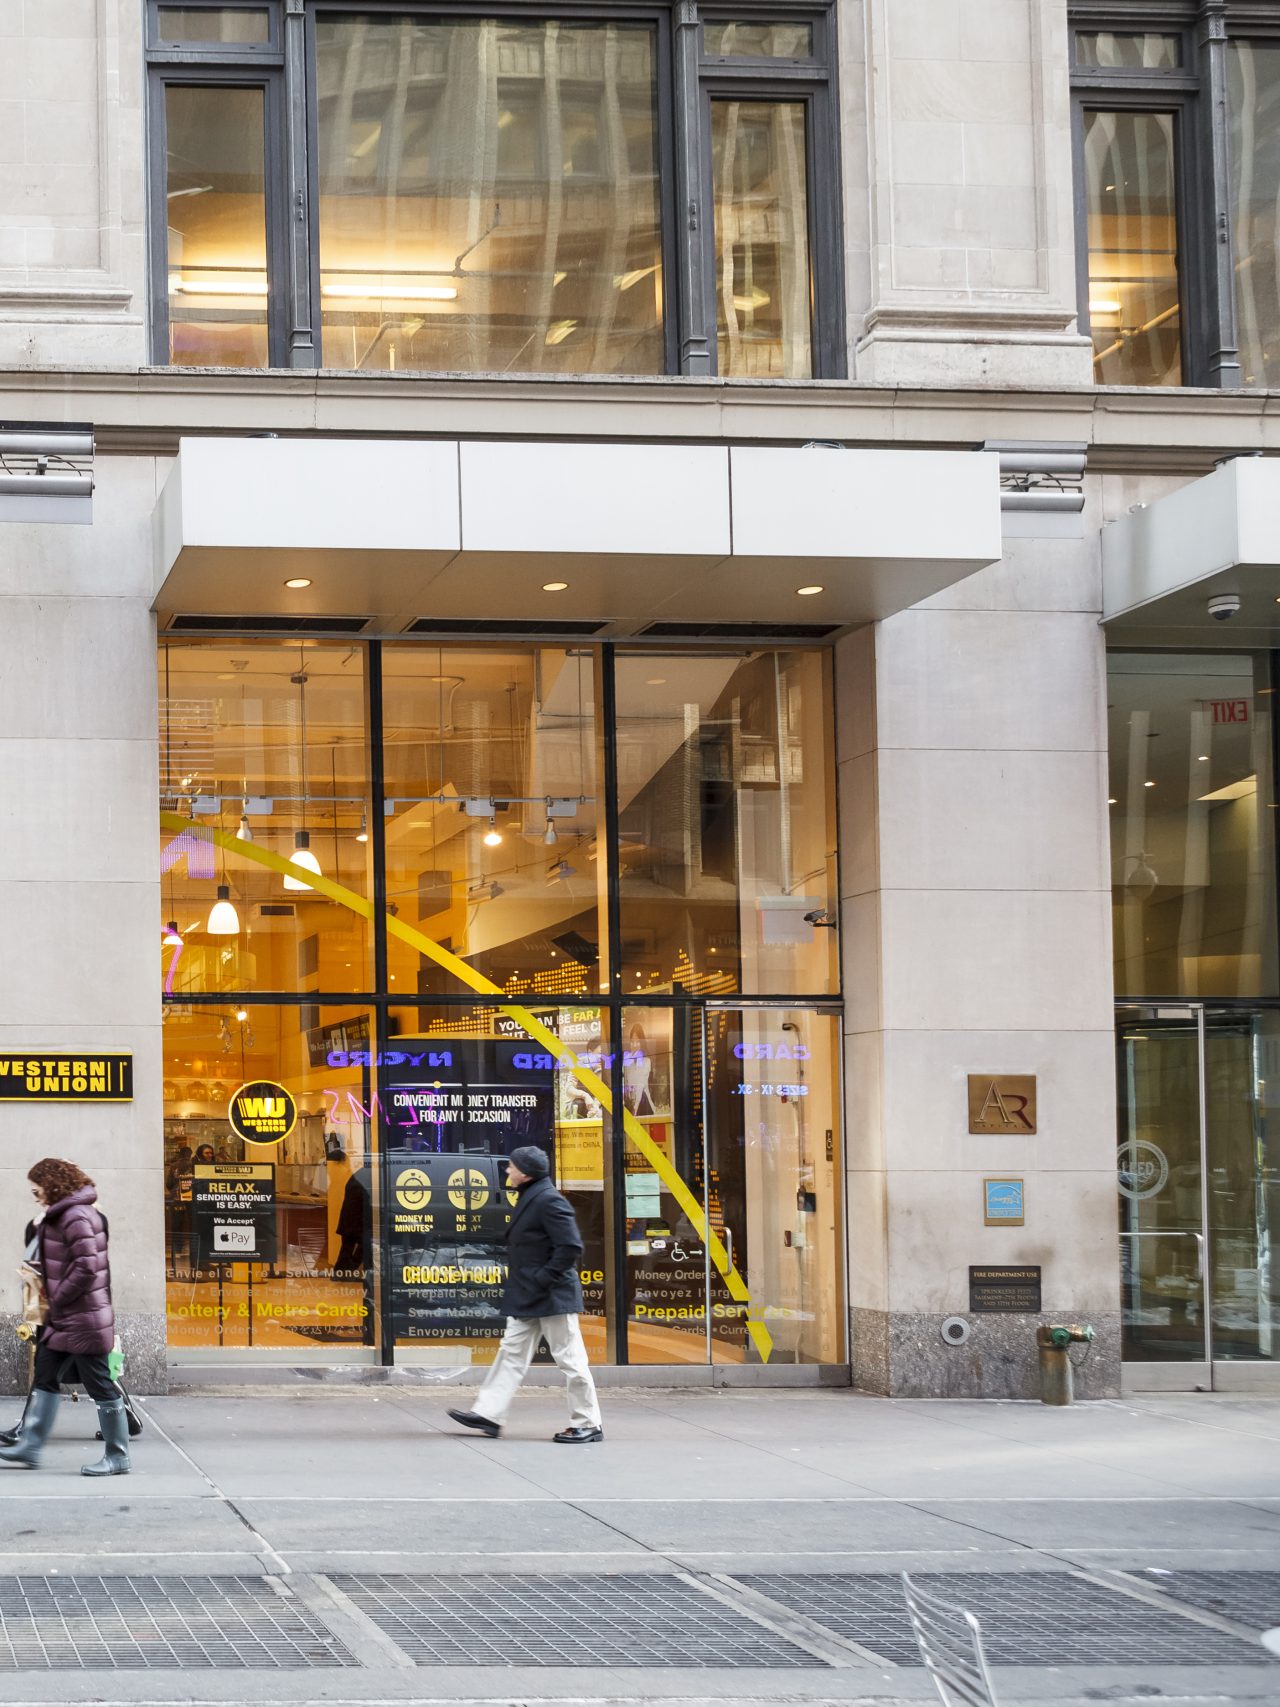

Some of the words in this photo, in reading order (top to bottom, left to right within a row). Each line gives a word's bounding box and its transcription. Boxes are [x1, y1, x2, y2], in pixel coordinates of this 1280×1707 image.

[536, 1016, 553, 1027] AN
[557, 1014, 571, 1025] BE
[573, 1010, 594, 1022] FAR
[563, 1024, 588, 1036] FEEL
[26, 1077, 106, 1092] UNION
[393, 1094, 449, 1107] CONVENIENT
[490, 1095, 537, 1107] TRANSFER
[237, 1097, 286, 1118] WU
[420, 1111, 438, 1122] FOR
[438, 1111, 460, 1122] ANY
[208, 1182, 260, 1194] RELAX.
[196, 1193, 237, 1202] SENDING
[239, 1194, 272, 1202] MONEY
[394, 1214, 423, 1223] MONEY
[424, 1215, 434, 1223] IN
[231, 1232, 250, 1245] Pay
[166, 1268, 204, 1279] Envie
[208, 1268, 220, 1279] el
[286, 1269, 319, 1279] Send
[324, 1269, 368, 1280] Money
[634, 1270, 671, 1282] Money
[674, 1269, 717, 1280] Orders
[460, 1288, 505, 1298] Service
[581, 1290, 604, 1299] ney
[635, 1287, 693, 1300] Envoyez
[166, 1302, 231, 1320] Lottery
[237, 1303, 250, 1317] &
[256, 1302, 309, 1317] Metro
[315, 1301, 369, 1317] Cards
[408, 1307, 441, 1318] Send
[634, 1304, 705, 1322] Prepaid
[408, 1326, 461, 1338] Envoyez
[464, 1325, 506, 1339] l'argen
